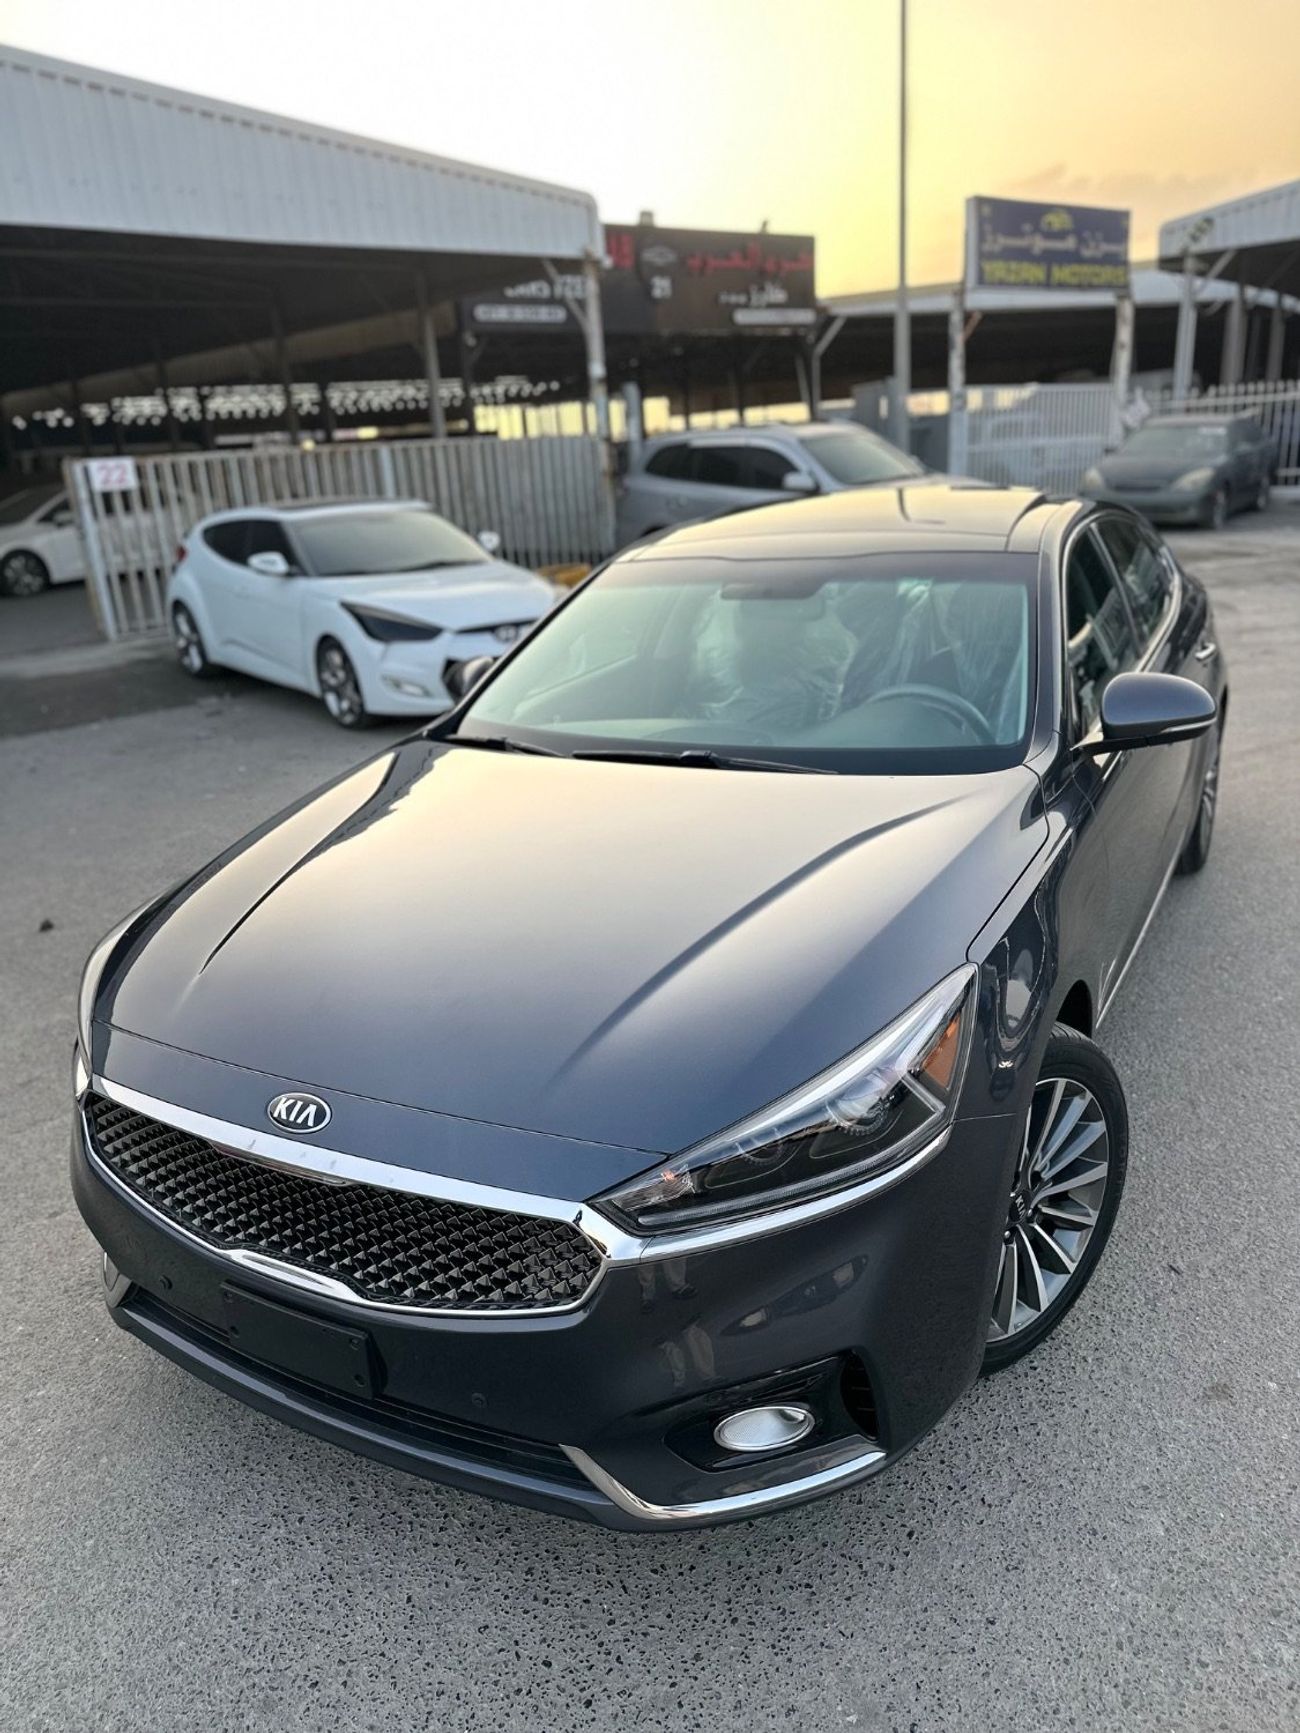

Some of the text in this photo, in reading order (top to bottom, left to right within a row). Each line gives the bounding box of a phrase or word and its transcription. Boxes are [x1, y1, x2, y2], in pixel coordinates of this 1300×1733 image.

[1051, 263, 1127, 286] MOTORS
[97, 463, 127, 488] 22
[273, 1096, 317, 1127] KIA
